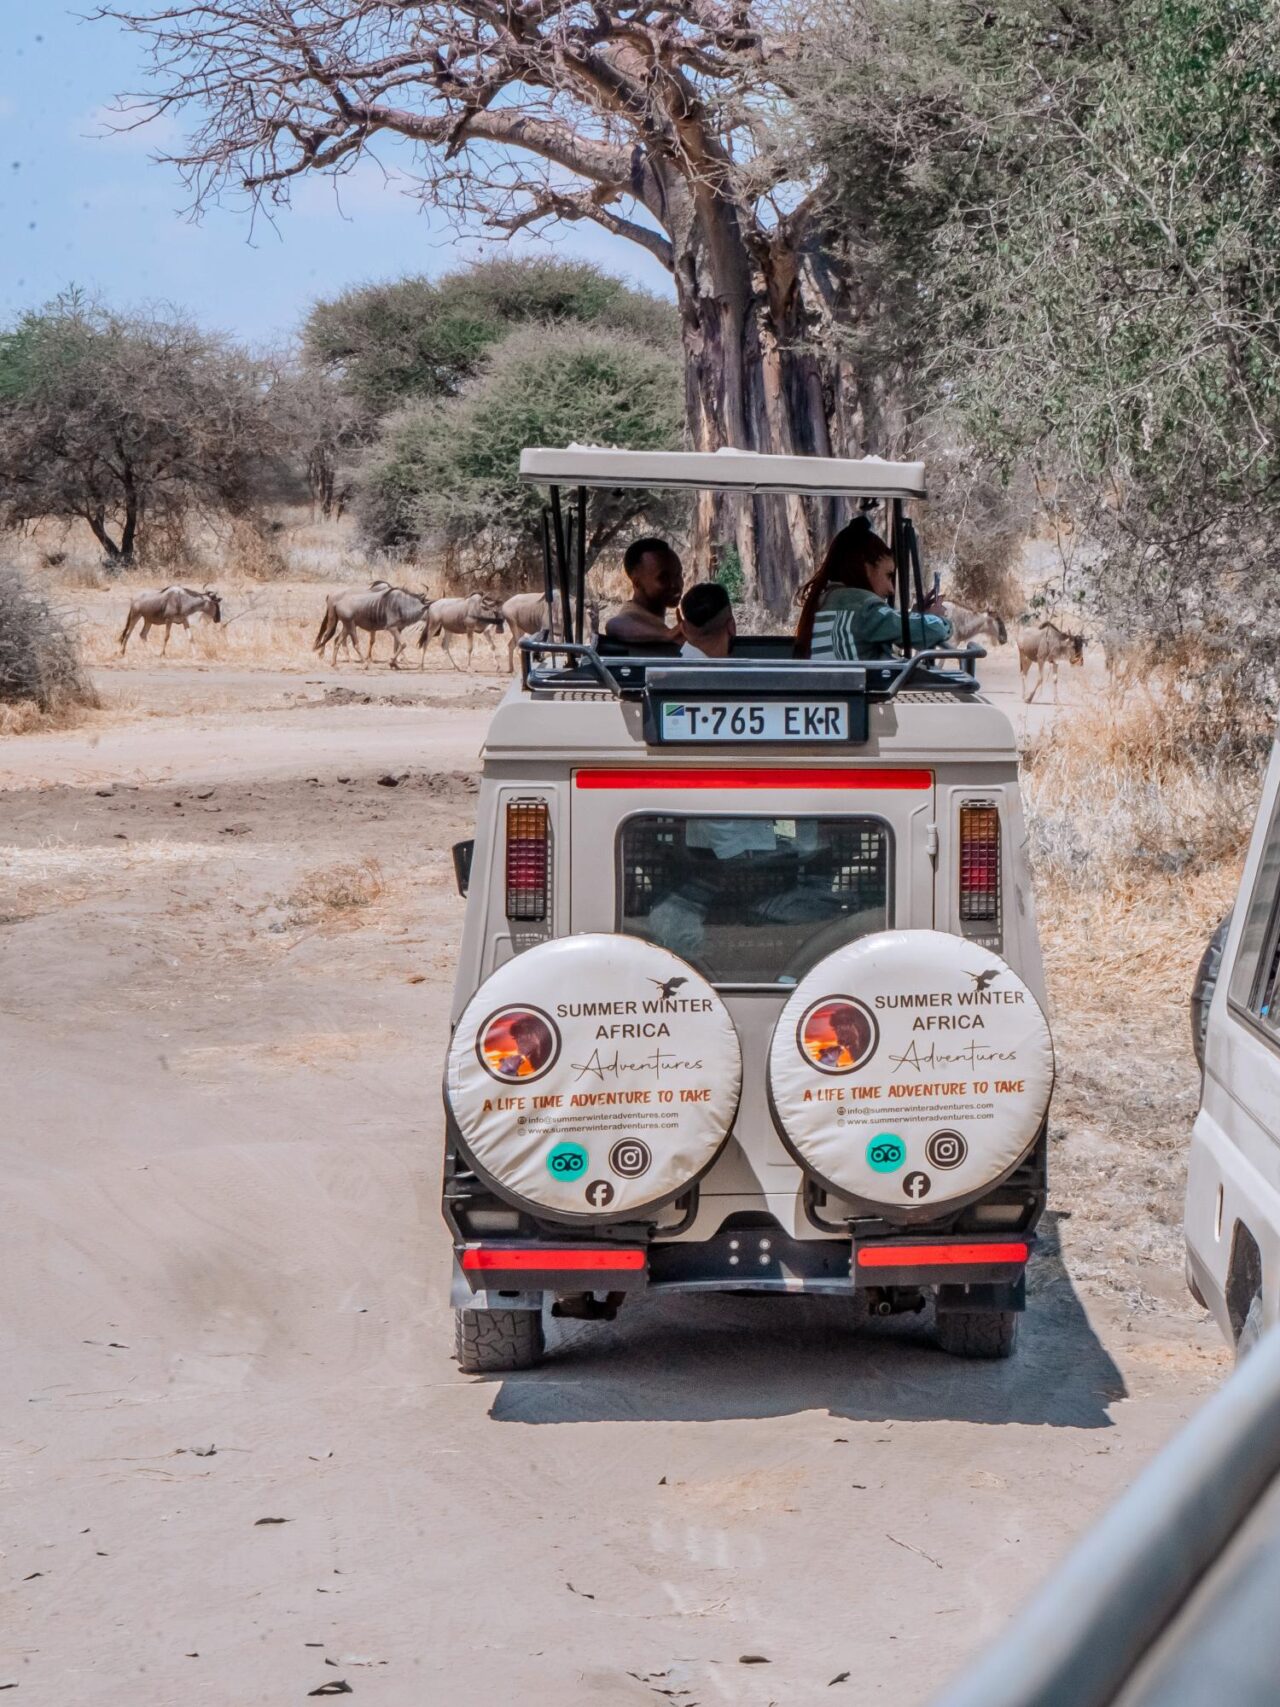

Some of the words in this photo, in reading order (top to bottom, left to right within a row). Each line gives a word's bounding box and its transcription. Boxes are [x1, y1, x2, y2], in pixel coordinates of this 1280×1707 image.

[784, 707, 841, 735] EKR
[556, 1001, 637, 1018] SUMMER
[642, 998, 713, 1014] WINTER
[874, 992, 952, 1009] SUMMER
[957, 990, 1025, 1006] WINTER
[595, 1022, 671, 1040] AFRICA
[912, 1014, 985, 1031] AFRICA
[570, 1048, 704, 1081] Adventures
[888, 1039, 1017, 1073] Adventures
[482, 1099, 493, 1112] A
[497, 1096, 526, 1111] LIFE
[532, 1094, 564, 1108] TIME
[570, 1090, 652, 1106] ADVENTURE
[657, 1090, 674, 1102] TO
[679, 1088, 712, 1102] TAKE
[803, 1089, 813, 1102] A
[818, 1087, 845, 1101] LIFE
[851, 1085, 882, 1099] TIME
[888, 1082, 967, 1098] ADVENTURE
[972, 1081, 989, 1094] TO
[994, 1080, 1026, 1093] TAKE
